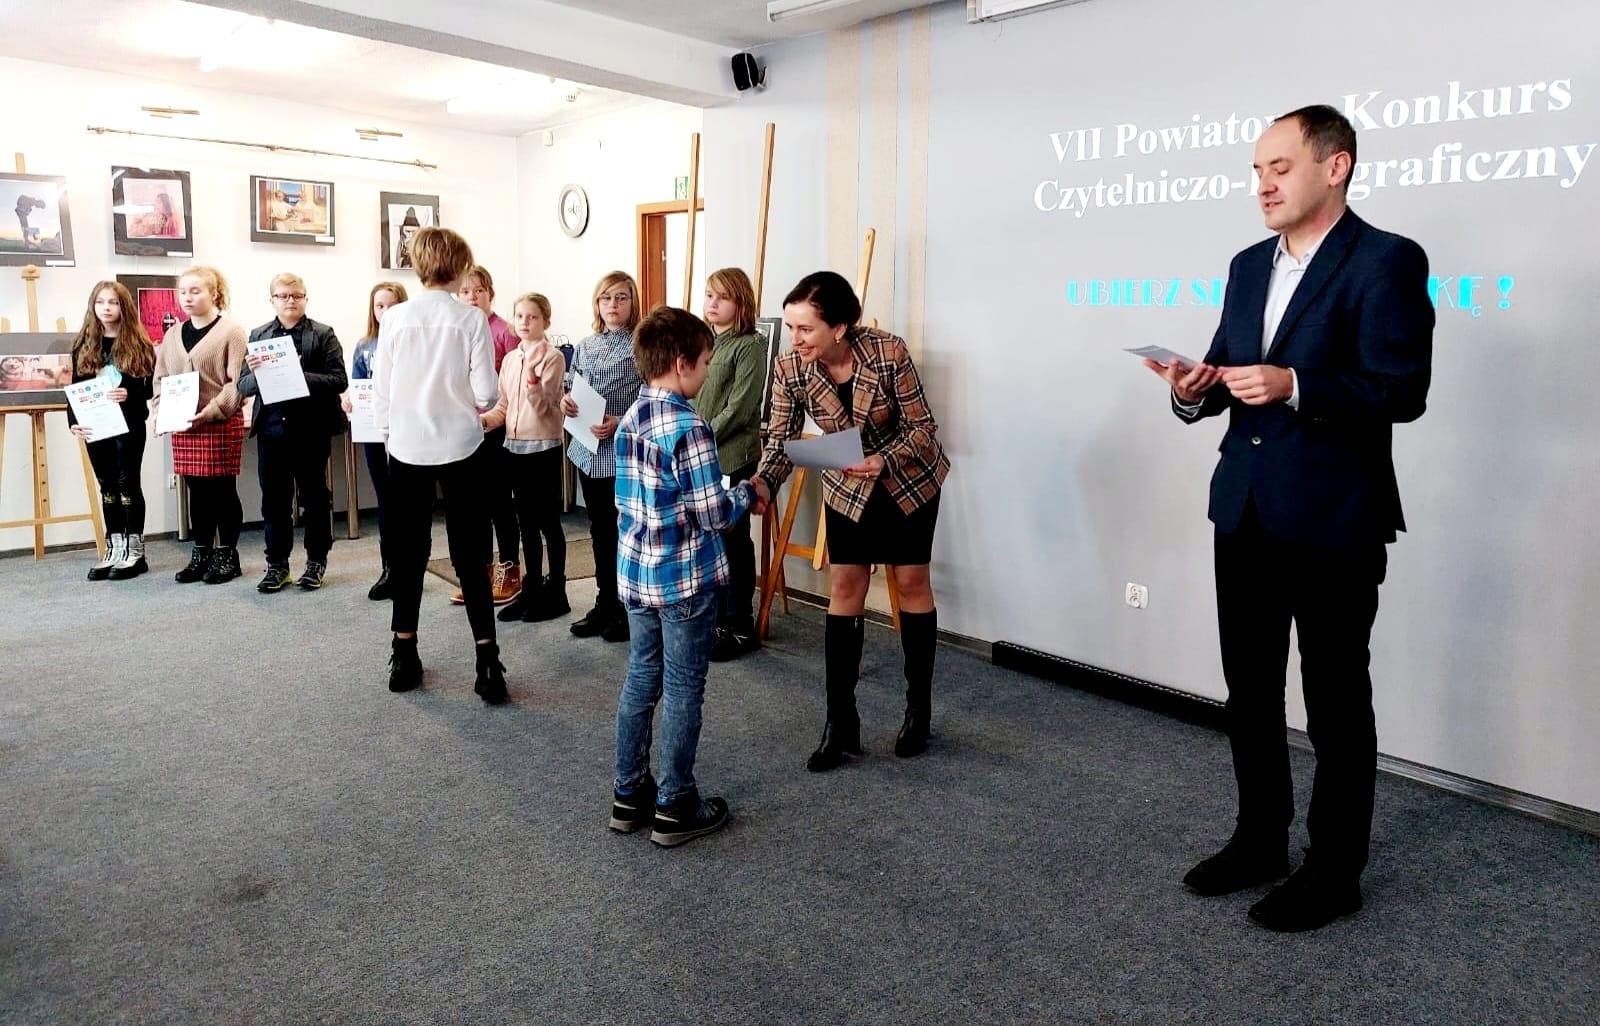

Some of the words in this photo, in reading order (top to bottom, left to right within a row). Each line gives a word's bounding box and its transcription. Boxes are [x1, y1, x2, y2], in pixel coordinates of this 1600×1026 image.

[1050, 127, 1104, 163] VII
[1113, 111, 1282, 157] Powiato
[1341, 78, 1572, 131] Konkurs
[1067, 279, 1182, 307] UBIERZ
[1190, 278, 1223, 307] SI
